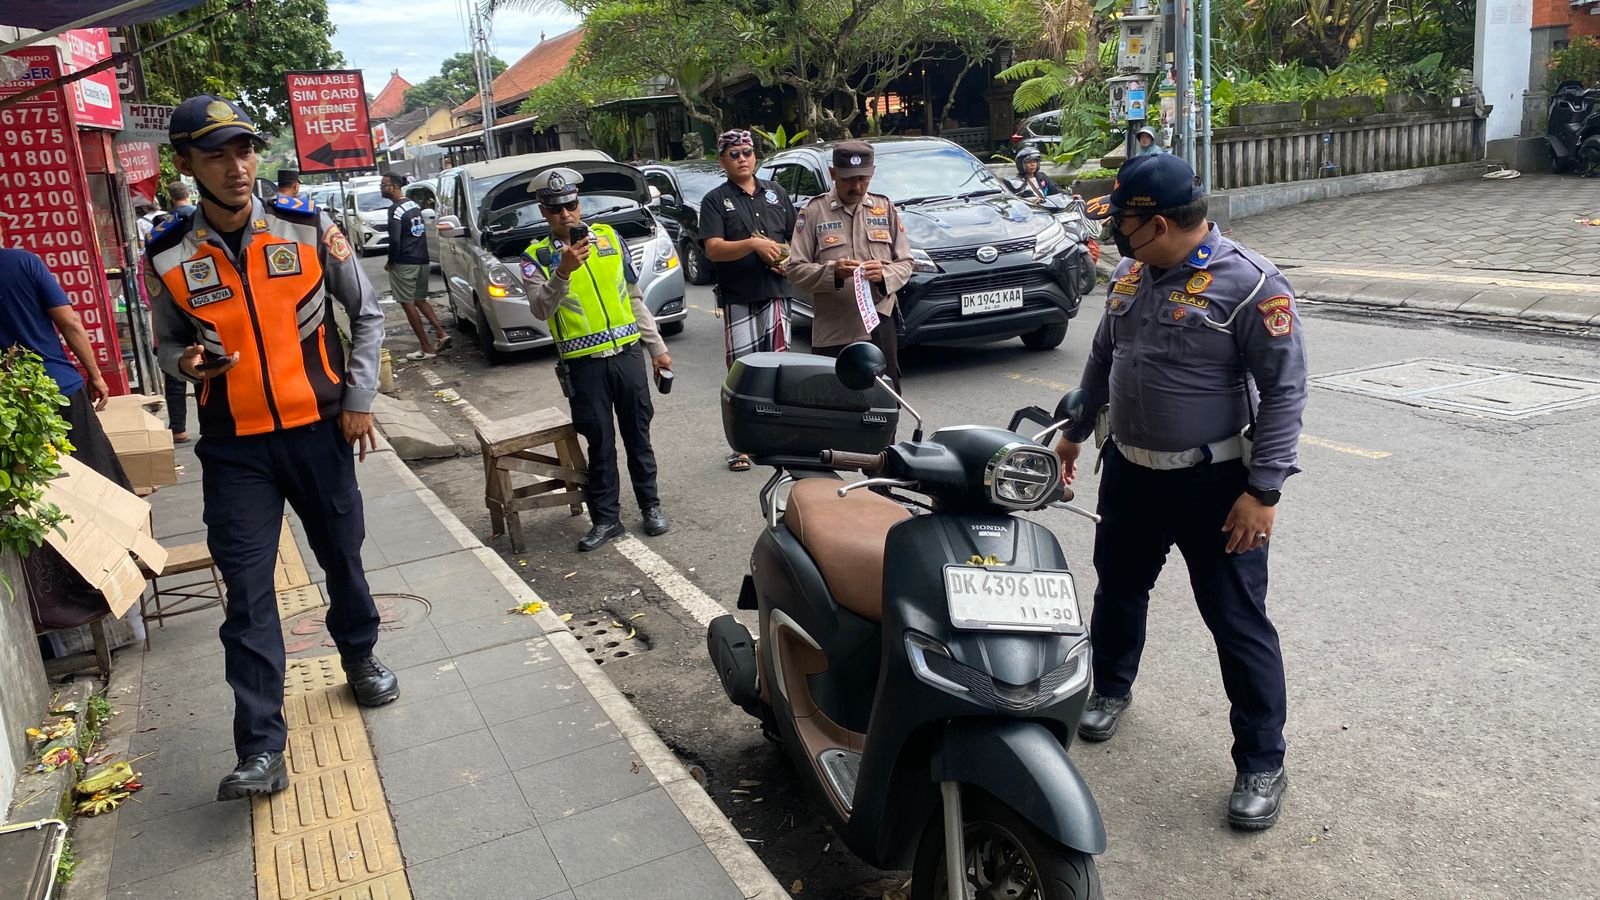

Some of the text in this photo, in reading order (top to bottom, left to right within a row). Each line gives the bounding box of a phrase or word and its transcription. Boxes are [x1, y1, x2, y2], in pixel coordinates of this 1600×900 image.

[293, 74, 356, 87] AVAILABLE
[292, 88, 359, 102] SIM CARD
[299, 103, 358, 116] INTERNET
[143, 117, 164, 125] BIKE
[305, 118, 358, 135] HERE
[0, 128, 64, 146] 9675
[0, 169, 71, 189] 10300
[3, 190, 75, 209] 12100
[7, 210, 79, 230] 22700
[817, 221, 843, 233] PANDE
[10, 230, 83, 249] 21400
[211, 289, 230, 300] NOVA
[963, 290, 1021, 308] DK 1941 KAA
[971, 524, 1008, 532] HONDA
[950, 572, 1072, 600] DK 4396 UCA
